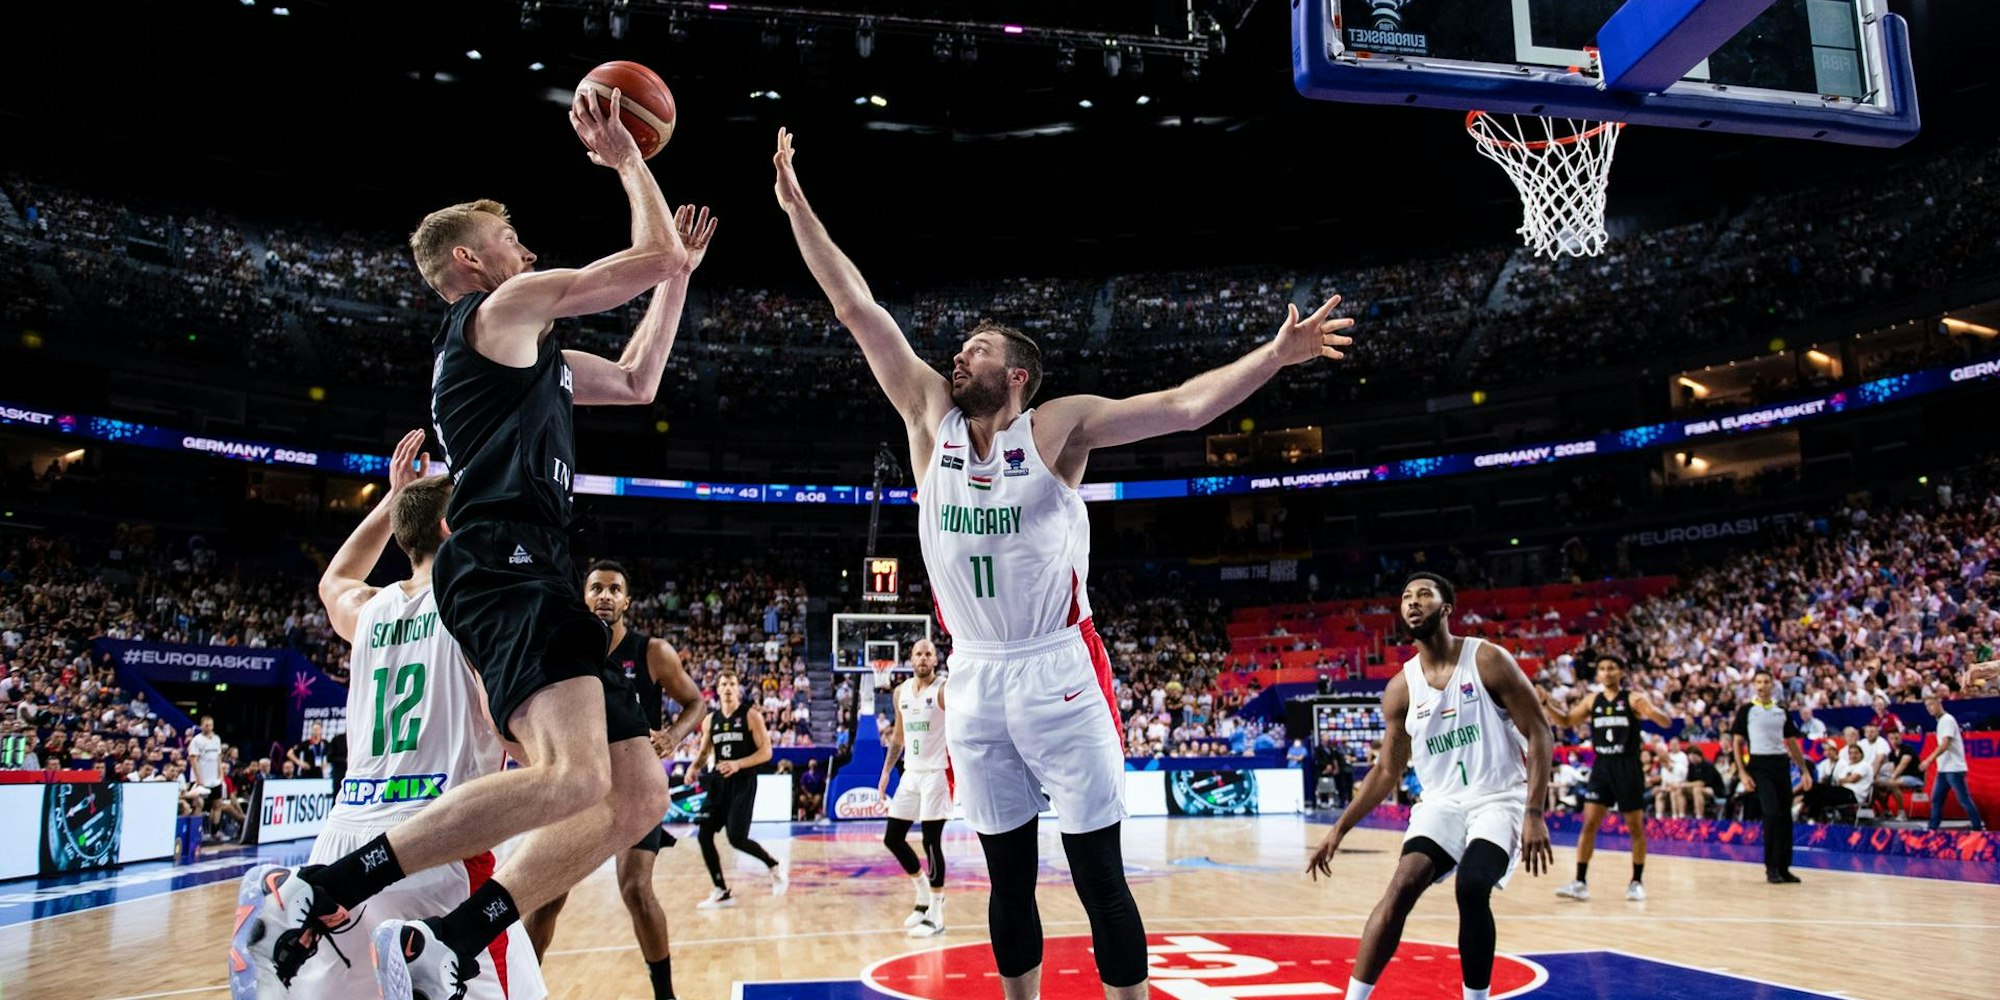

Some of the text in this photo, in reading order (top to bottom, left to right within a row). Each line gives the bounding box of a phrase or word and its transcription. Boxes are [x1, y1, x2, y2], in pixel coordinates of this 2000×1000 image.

[1684, 399, 1826, 436] FIBA EUROBASKET
[182, 436, 318, 465] GERMANY 2022
[1474, 440, 1597, 467] GERMANY 2022
[711, 486, 735, 494] HUN
[1251, 469, 1371, 489] FIBA EUROBASKET
[794, 492, 827, 502] 8:08
[889, 490, 909, 498] GER
[940, 504, 1022, 535] HUNGARY
[508, 554, 534, 564] PEAK
[970, 556, 995, 598] 11
[123, 649, 275, 671] #EUROBASKET
[372, 663, 426, 757] 12
[913, 739, 919, 755] 9
[1426, 723, 1481, 755] HUNGARY
[1457, 760, 1468, 786] 1
[286, 793, 335, 824] TISSOT
[360, 844, 388, 873] PEAK
[482, 897, 509, 922] PEAK
